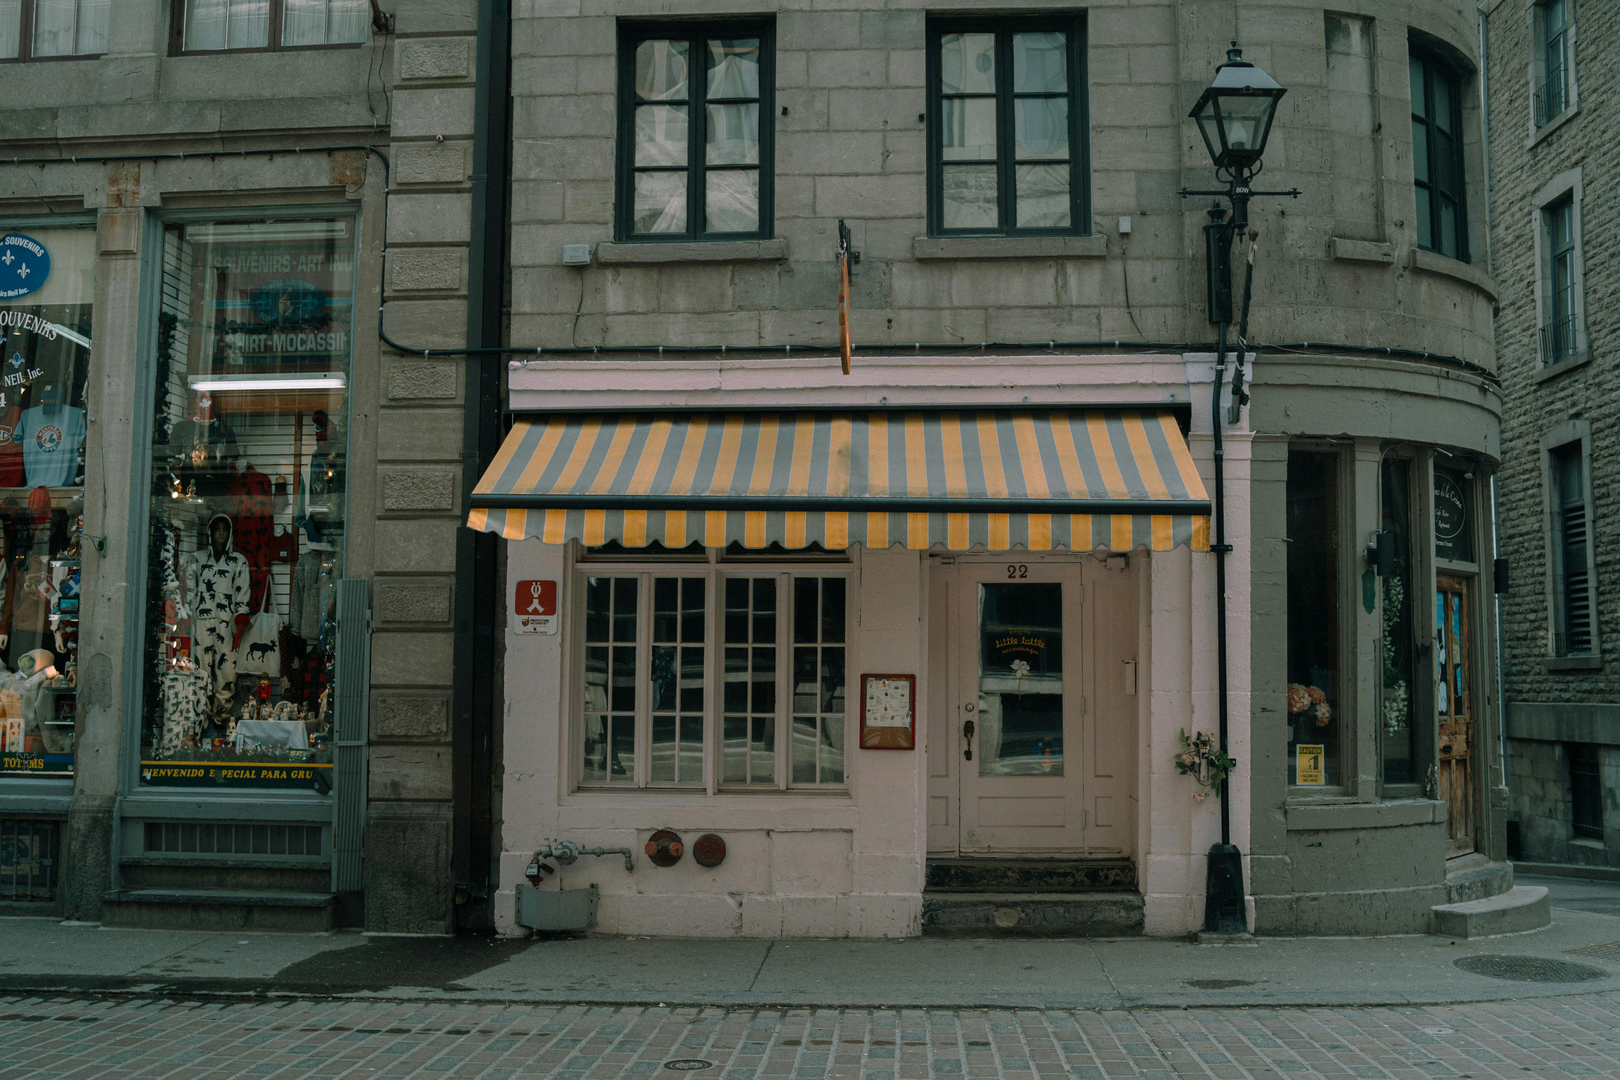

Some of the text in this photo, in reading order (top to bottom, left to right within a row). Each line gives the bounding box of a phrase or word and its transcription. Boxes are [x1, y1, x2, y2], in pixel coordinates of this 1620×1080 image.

[5, 236, 45, 258] SOUVENIRS
[213, 254, 324, 274] SOUVENIRS-ART
[4, 367, 44, 388] NEIL Inc.
[1007, 564, 1028, 579] 22
[3, 757, 45, 770] TOTMS
[142, 768, 205, 778] BIENVENIDO
[208, 769, 257, 779] EPECIAL
[260, 770, 288, 780] PARA
